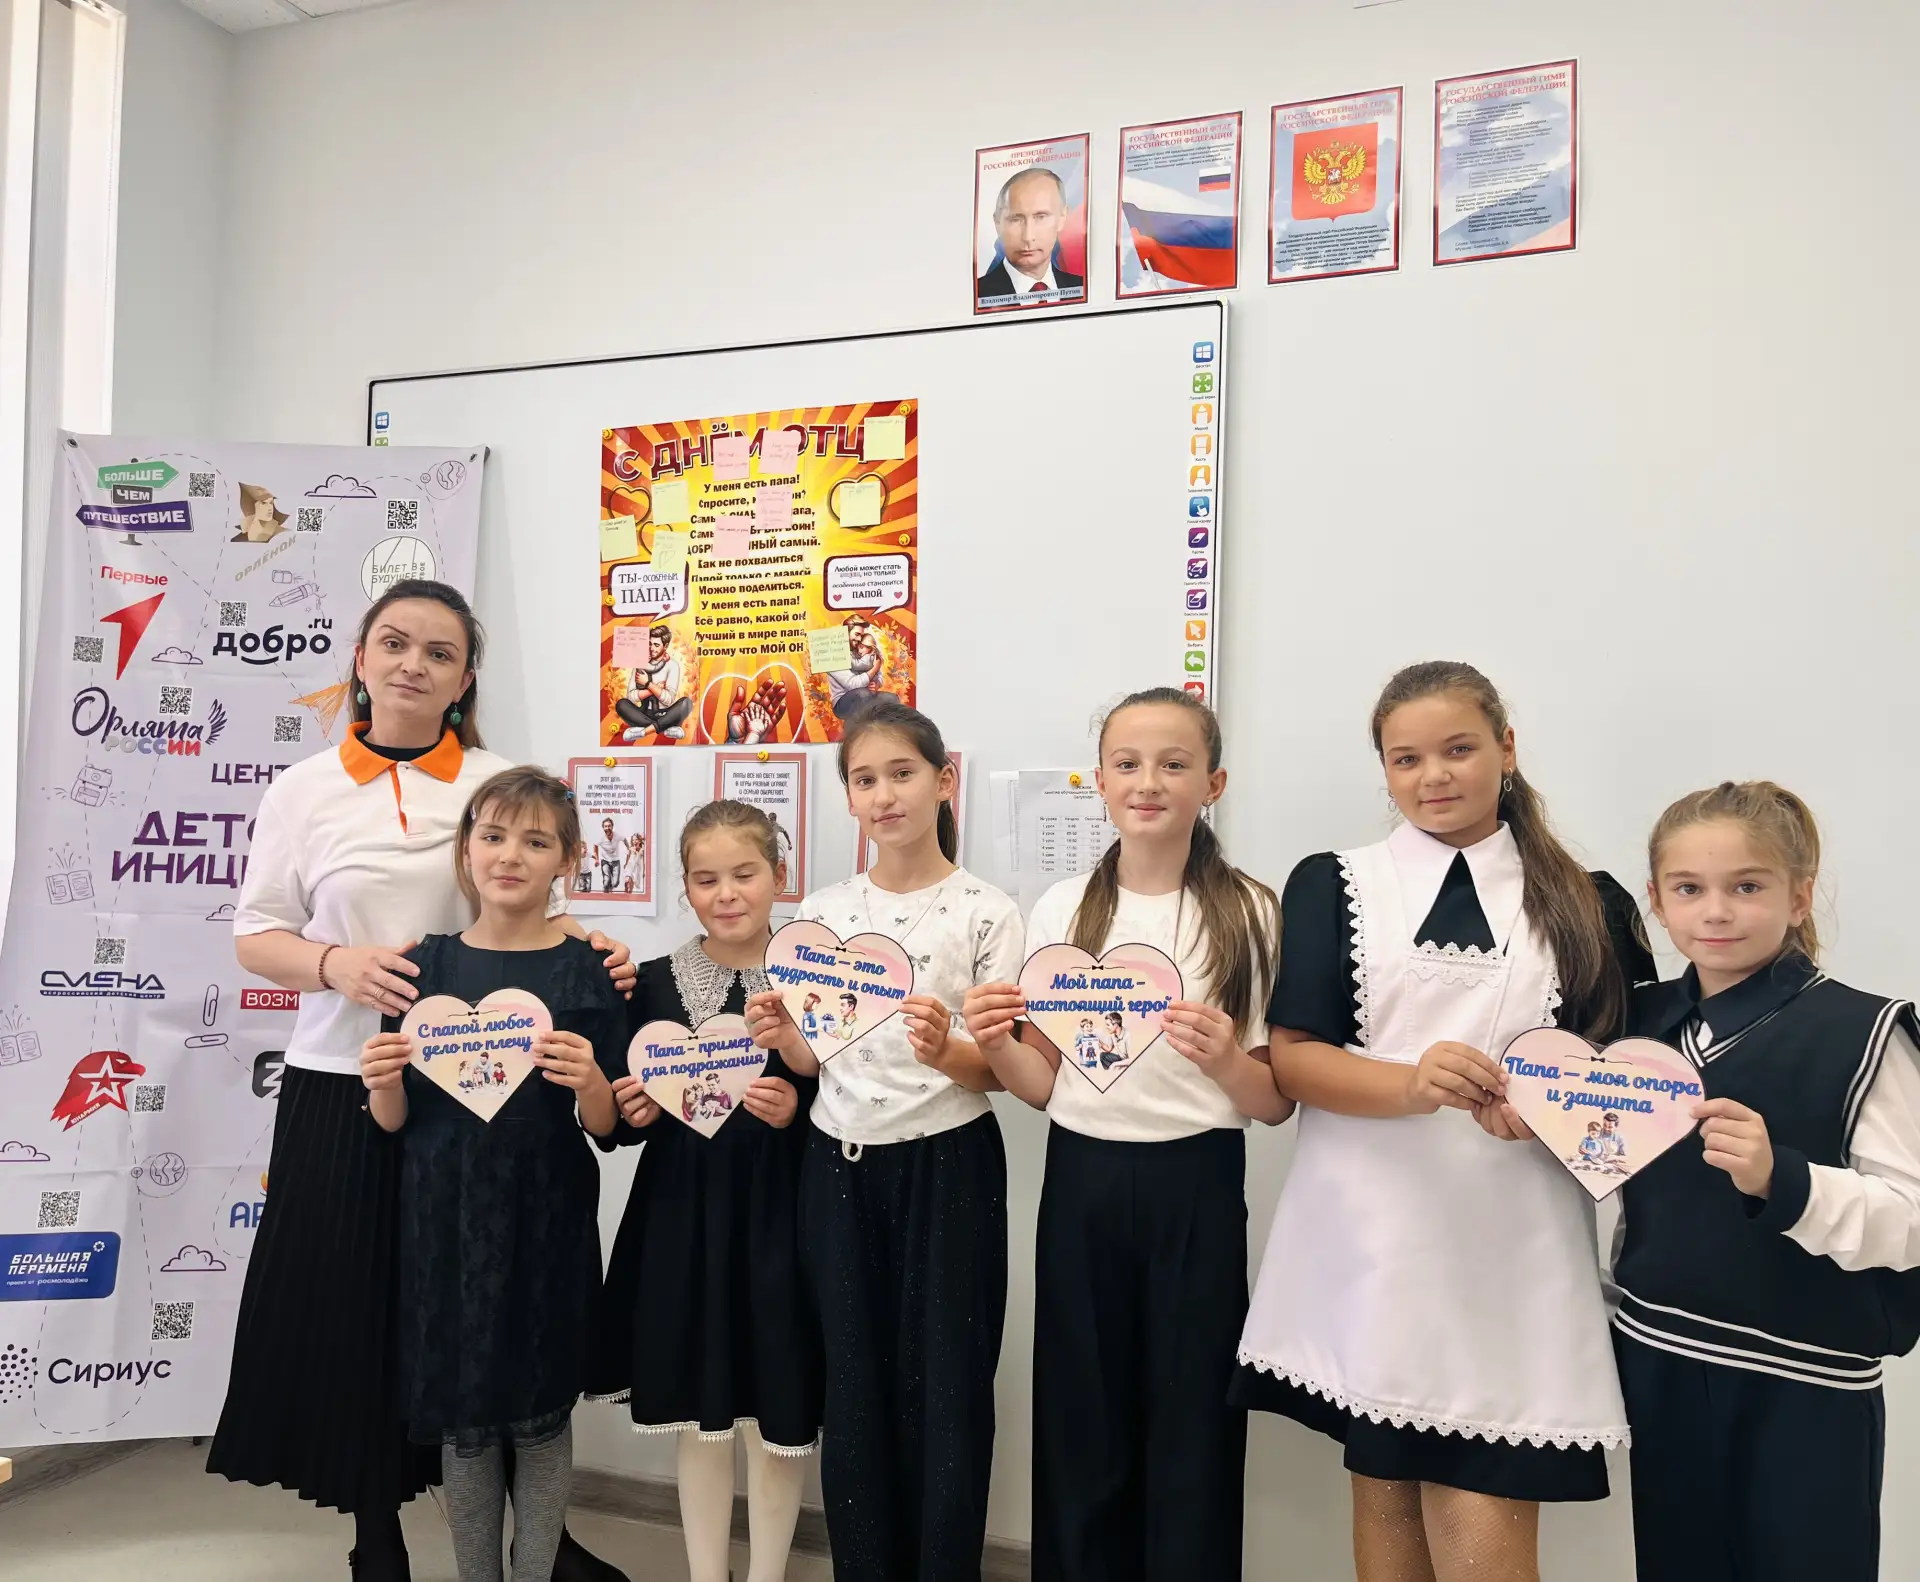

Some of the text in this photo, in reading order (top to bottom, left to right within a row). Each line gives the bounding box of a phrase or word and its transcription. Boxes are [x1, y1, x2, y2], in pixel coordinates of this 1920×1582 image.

[1539, 72, 1566, 82] ГИМН
[1445, 81, 1566, 105] РОССИЙСКОЙ ФЕДЕРАЦИИ
[1128, 132, 1233, 151] РОССИЙСКОЙ ФЕДЕРАЦИИ
[983, 158, 1034, 170] РОССИЙСКОЙ
[613, 448, 642, 482] С
[104, 469, 164, 482] БОЛЬШЕ
[704, 474, 800, 493] У меня есть папа!
[116, 489, 150, 501] ЧЕМ
[83, 510, 186, 525] ПУТЕШЕСТВИЕ
[372, 562, 418, 574] БИЛЕТ В
[718, 558, 732, 567] не
[735, 554, 803, 567] похвалиться
[834, 565, 858, 573] Любой
[859, 564, 882, 572] может
[100, 565, 168, 586] Первые
[867, 579, 904, 587] становится
[738, 581, 805, 593] поделиться.
[852, 588, 883, 599] ПАПОЙ
[701, 595, 800, 610] У меня есть папа!
[716, 615, 753, 627] равно,
[755, 611, 789, 622] какой
[212, 624, 331, 662] добро
[738, 631, 745, 639] в
[747, 630, 777, 641] мире
[738, 646, 758, 655] что
[760, 640, 786, 654] МОЙ
[72, 686, 204, 744] Орлята
[104, 735, 201, 757] РОССИИ
[794, 944, 887, 976] Папа это
[41, 970, 165, 990] СМЕНА
[767, 963, 906, 1001] мудрость и опыт
[1050, 973, 1135, 990] Мой папа
[1026, 995, 1126, 1015] настоящий
[418, 1012, 535, 1038] С папой любое
[422, 1035, 534, 1063] дело по плечу
[645, 1036, 755, 1059] Папа пример
[641, 1053, 766, 1084] для подражания
[1504, 1056, 1702, 1101] Папа моя опора
[1546, 1088, 1655, 1114] и защита
[11, 1252, 92, 1264] БОЛЬШАЯ
[8, 1263, 88, 1275] ПЕРЕМЕНА
[48, 1358, 172, 1389] Сириус
